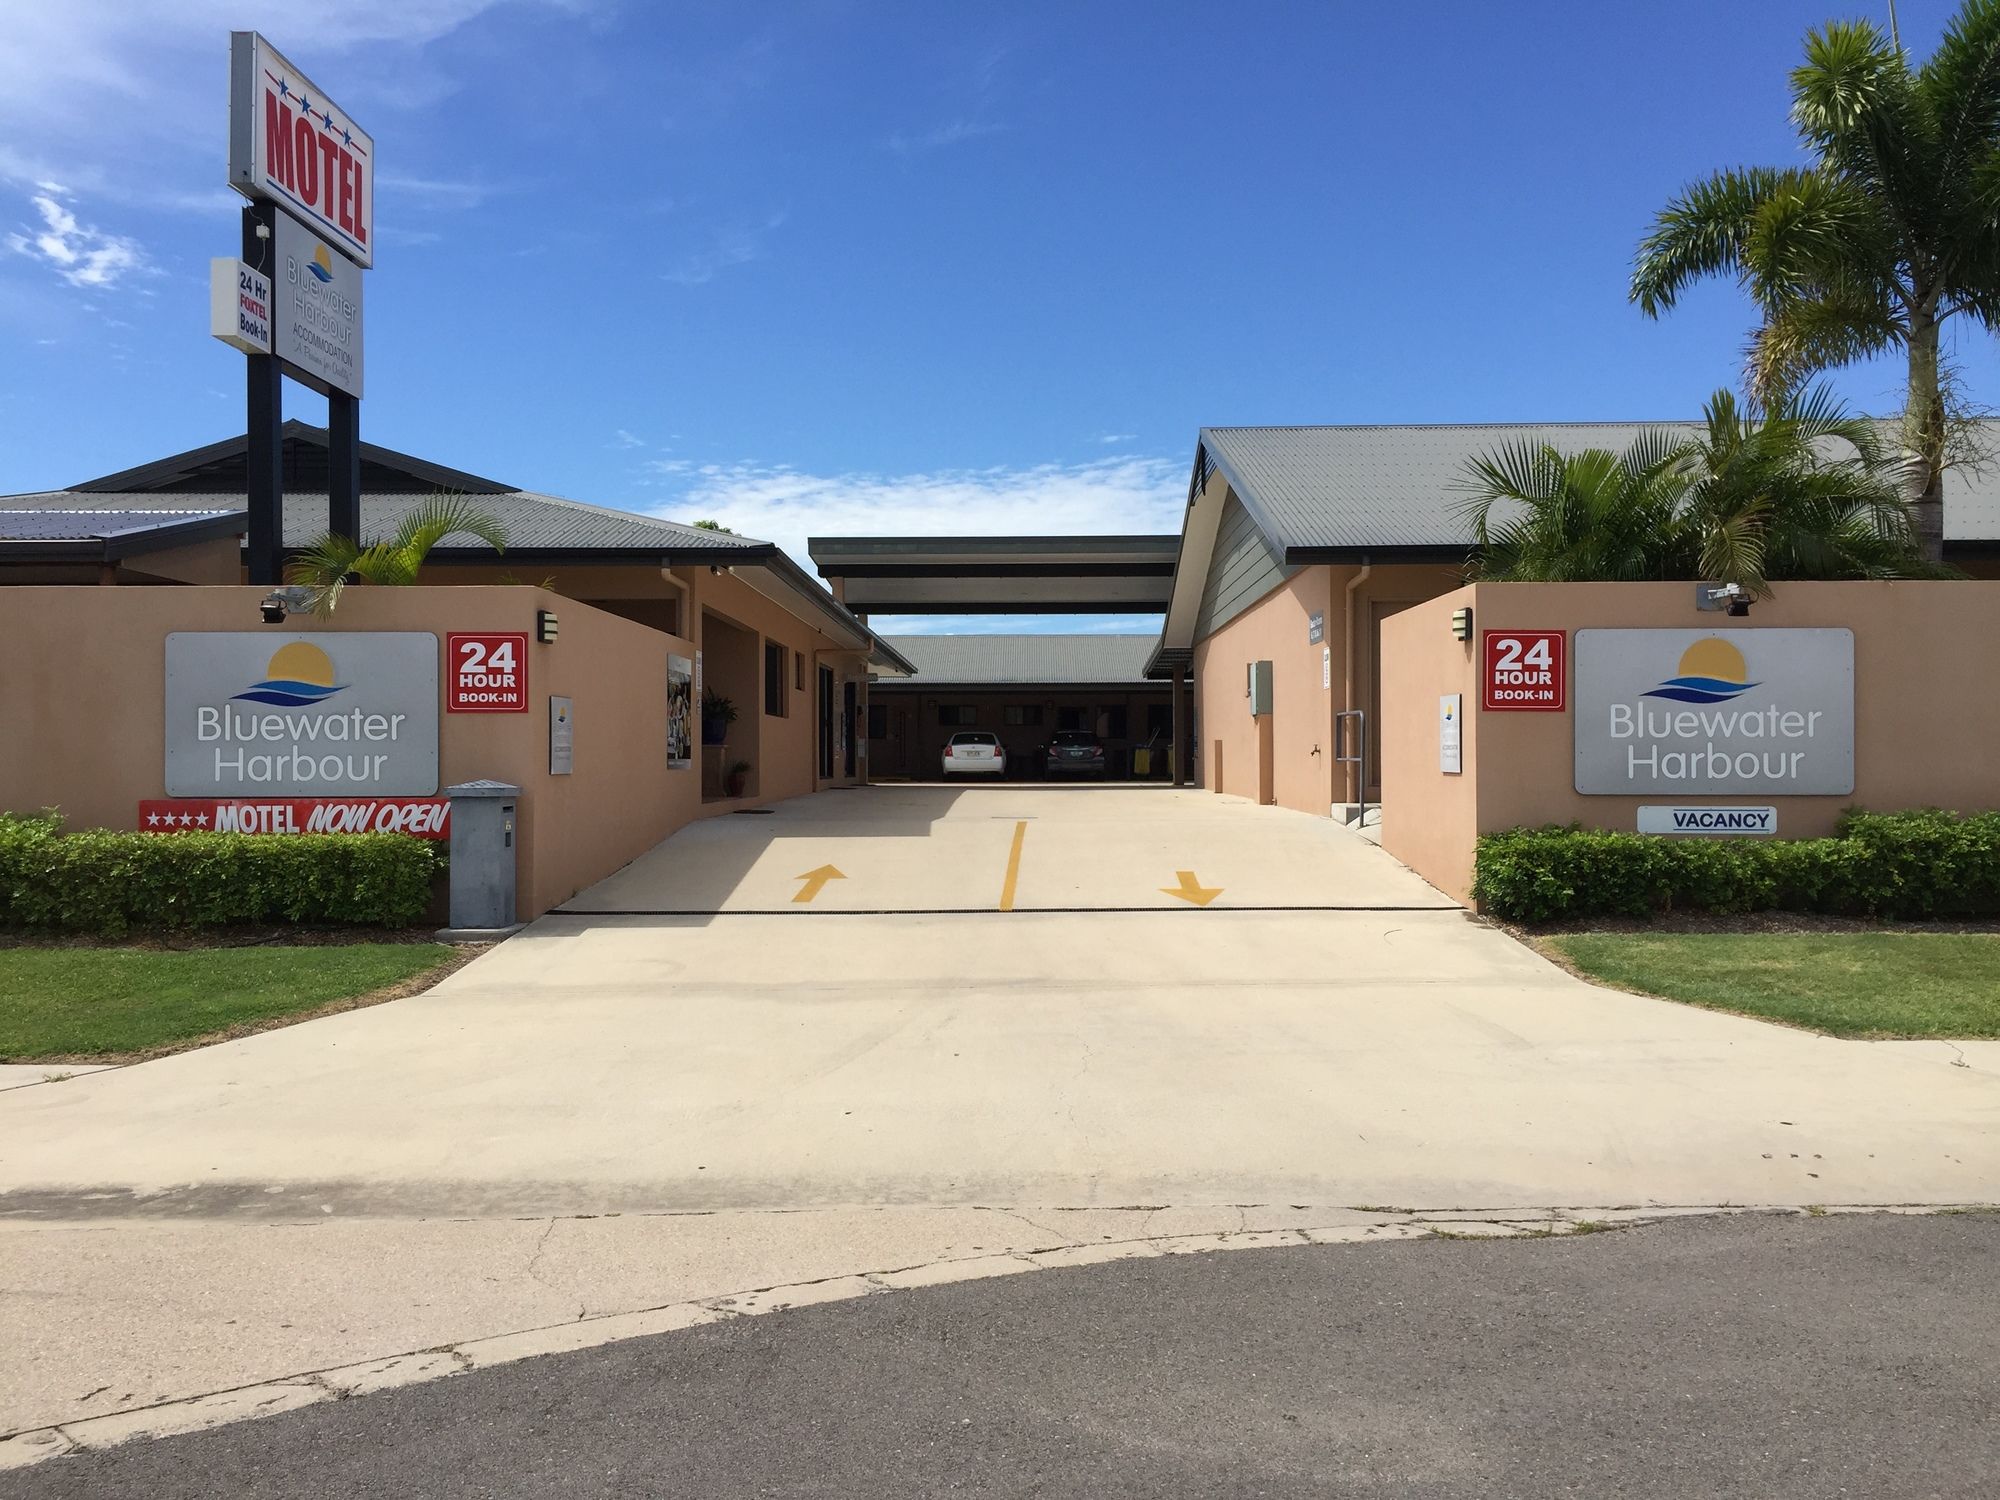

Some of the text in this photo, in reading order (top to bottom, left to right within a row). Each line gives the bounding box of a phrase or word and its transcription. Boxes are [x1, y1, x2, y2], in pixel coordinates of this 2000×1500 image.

[266, 87, 366, 244] MOTEL
[240, 271, 267, 301] 24 Hr
[287, 255, 356, 322] Bluewater
[240, 293, 267, 321] FOXTEL
[293, 289, 351, 343] Harbour
[240, 312, 268, 343] Book-In
[293, 322, 353, 368] ACCOMMODATION
[460, 642, 516, 673] 24
[1495, 639, 1552, 670] 24
[459, 674, 516, 687] HOUR
[1494, 671, 1552, 685] HOUR
[459, 692, 517, 703] BOOK-IN
[1494, 690, 1553, 700] BOOK-IN
[197, 704, 406, 741] Bluewater
[1610, 702, 1822, 738] Bluewater
[215, 745, 388, 782] Harbour
[1628, 742, 1805, 779] Harbour
[214, 802, 451, 834] MOTEL NOW OPEN
[1673, 812, 1770, 829] VACANCY
